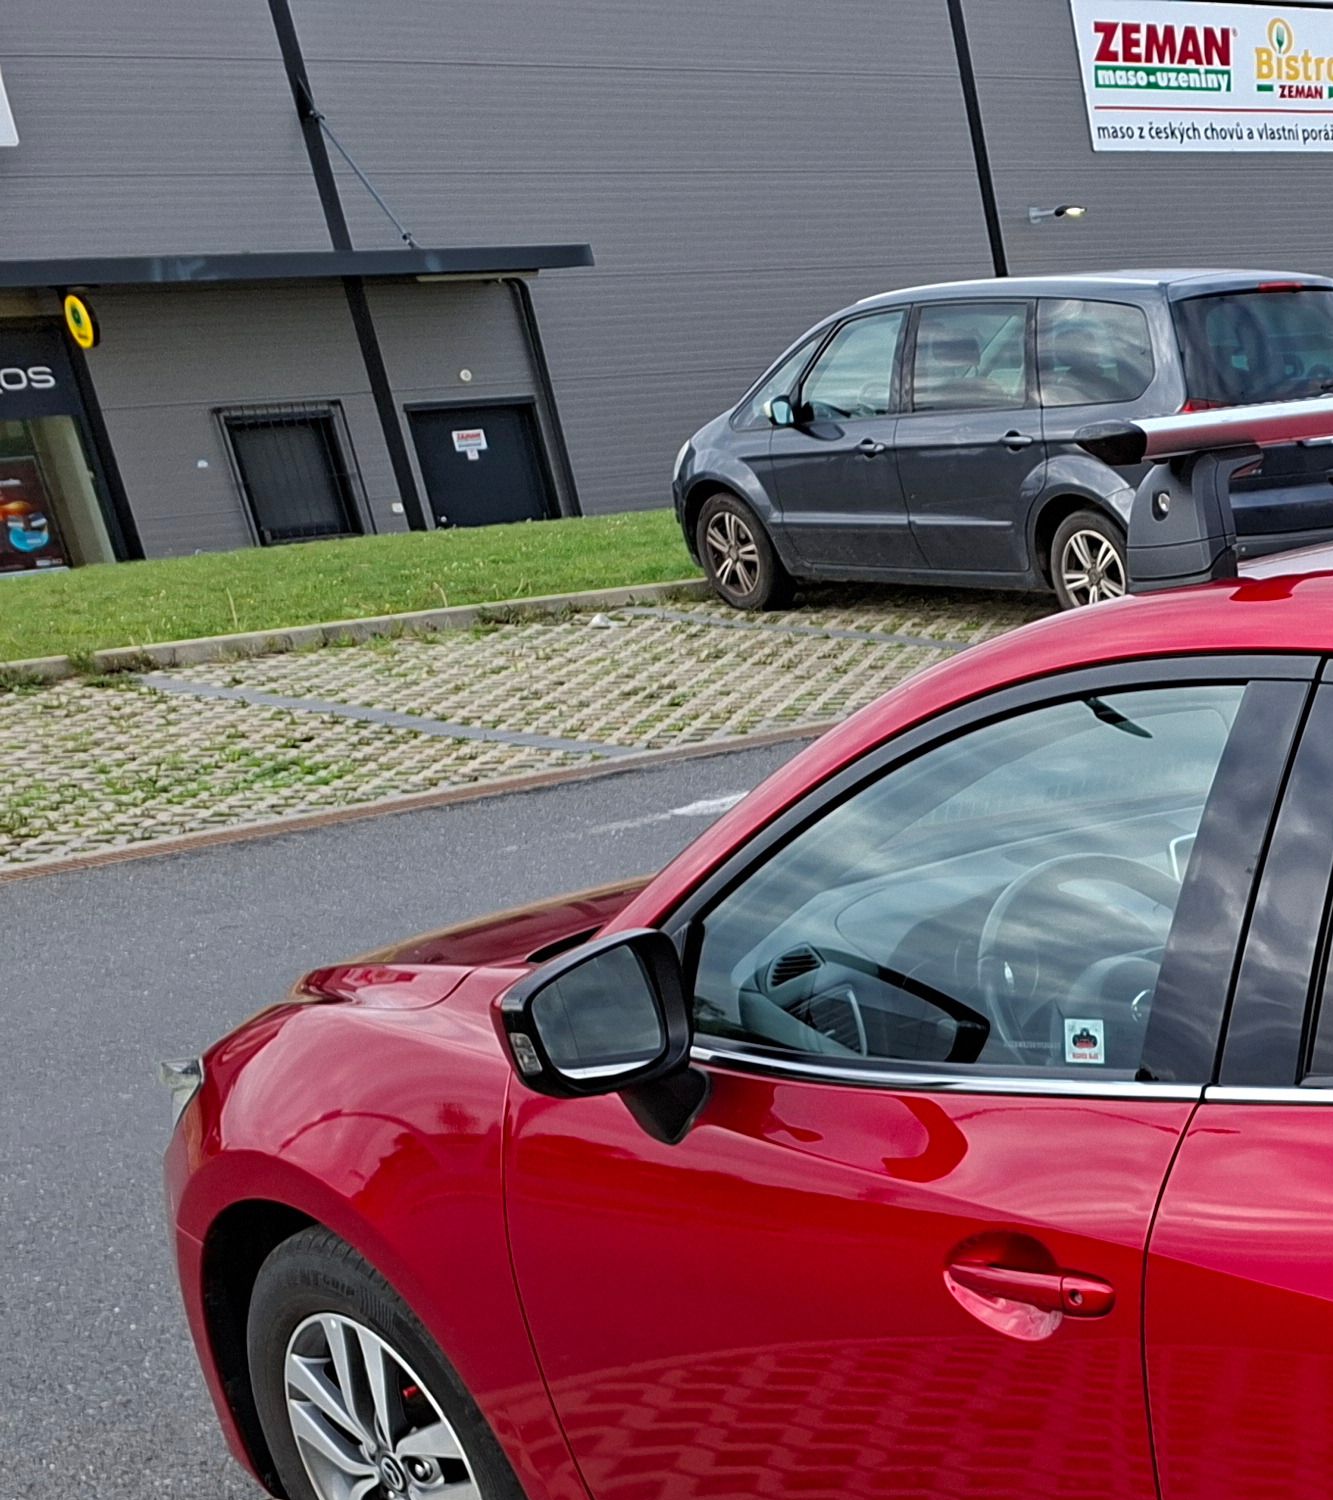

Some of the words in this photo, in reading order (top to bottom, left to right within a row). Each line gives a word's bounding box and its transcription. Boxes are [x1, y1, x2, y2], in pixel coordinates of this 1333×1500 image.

[1094, 21, 1230, 66] ZEMAN
[1097, 68, 1229, 92] maso-uzeniny
[1279, 84, 1323, 99] ZEMAN
[1097, 126, 1134, 139] maso
[1137, 126, 1145, 139] z
[1148, 121, 1201, 144] českých
[1204, 121, 1243, 140] chovů
[1246, 127, 1254, 140] a
[1257, 122, 1299, 140] vlastní
[0, 366, 56, 394] OS
